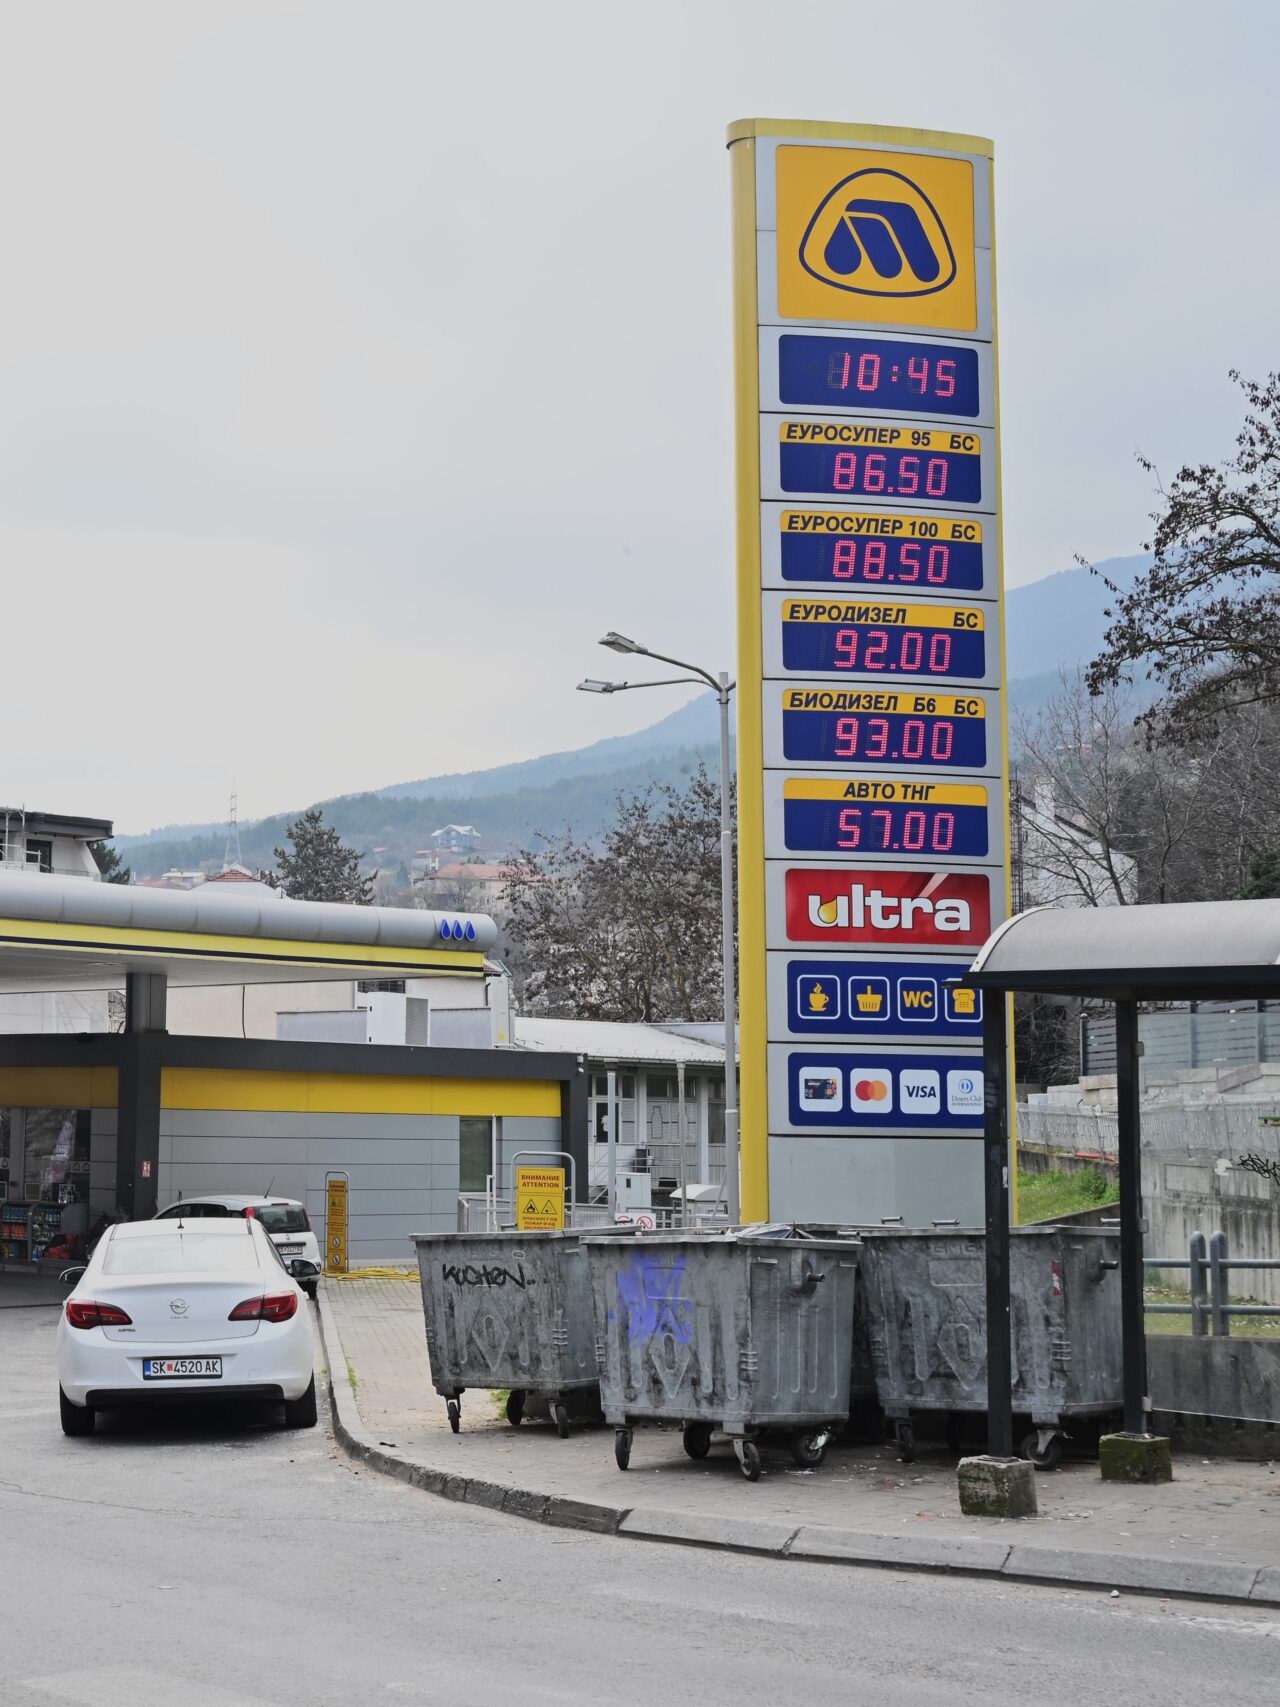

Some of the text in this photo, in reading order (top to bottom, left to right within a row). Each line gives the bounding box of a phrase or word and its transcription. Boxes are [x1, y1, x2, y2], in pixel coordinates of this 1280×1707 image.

[841, 352, 957, 397] 10:45
[786, 423, 975, 451] ЕУРОСУПЕР 95 БС
[832, 452, 949, 496] 86.50
[787, 514, 976, 541] ЕУРОСУПЕР 100 БС
[832, 540, 950, 583] 88.50
[788, 603, 978, 629] ЕУРОДИЗЕЛ БС
[834, 629, 952, 672] 92.00
[789, 691, 979, 716] БИОДИЗЕЛ Б6 БС
[834, 717, 954, 760] 93.00
[843, 782, 935, 801] АВТО ТНГ
[836, 808, 955, 851] 57.00
[807, 883, 971, 932] ultra
[902, 990, 933, 1009] WC
[904, 1084, 937, 1099] VISA
[152, 1360, 219, 1374] SK 4520 AK
